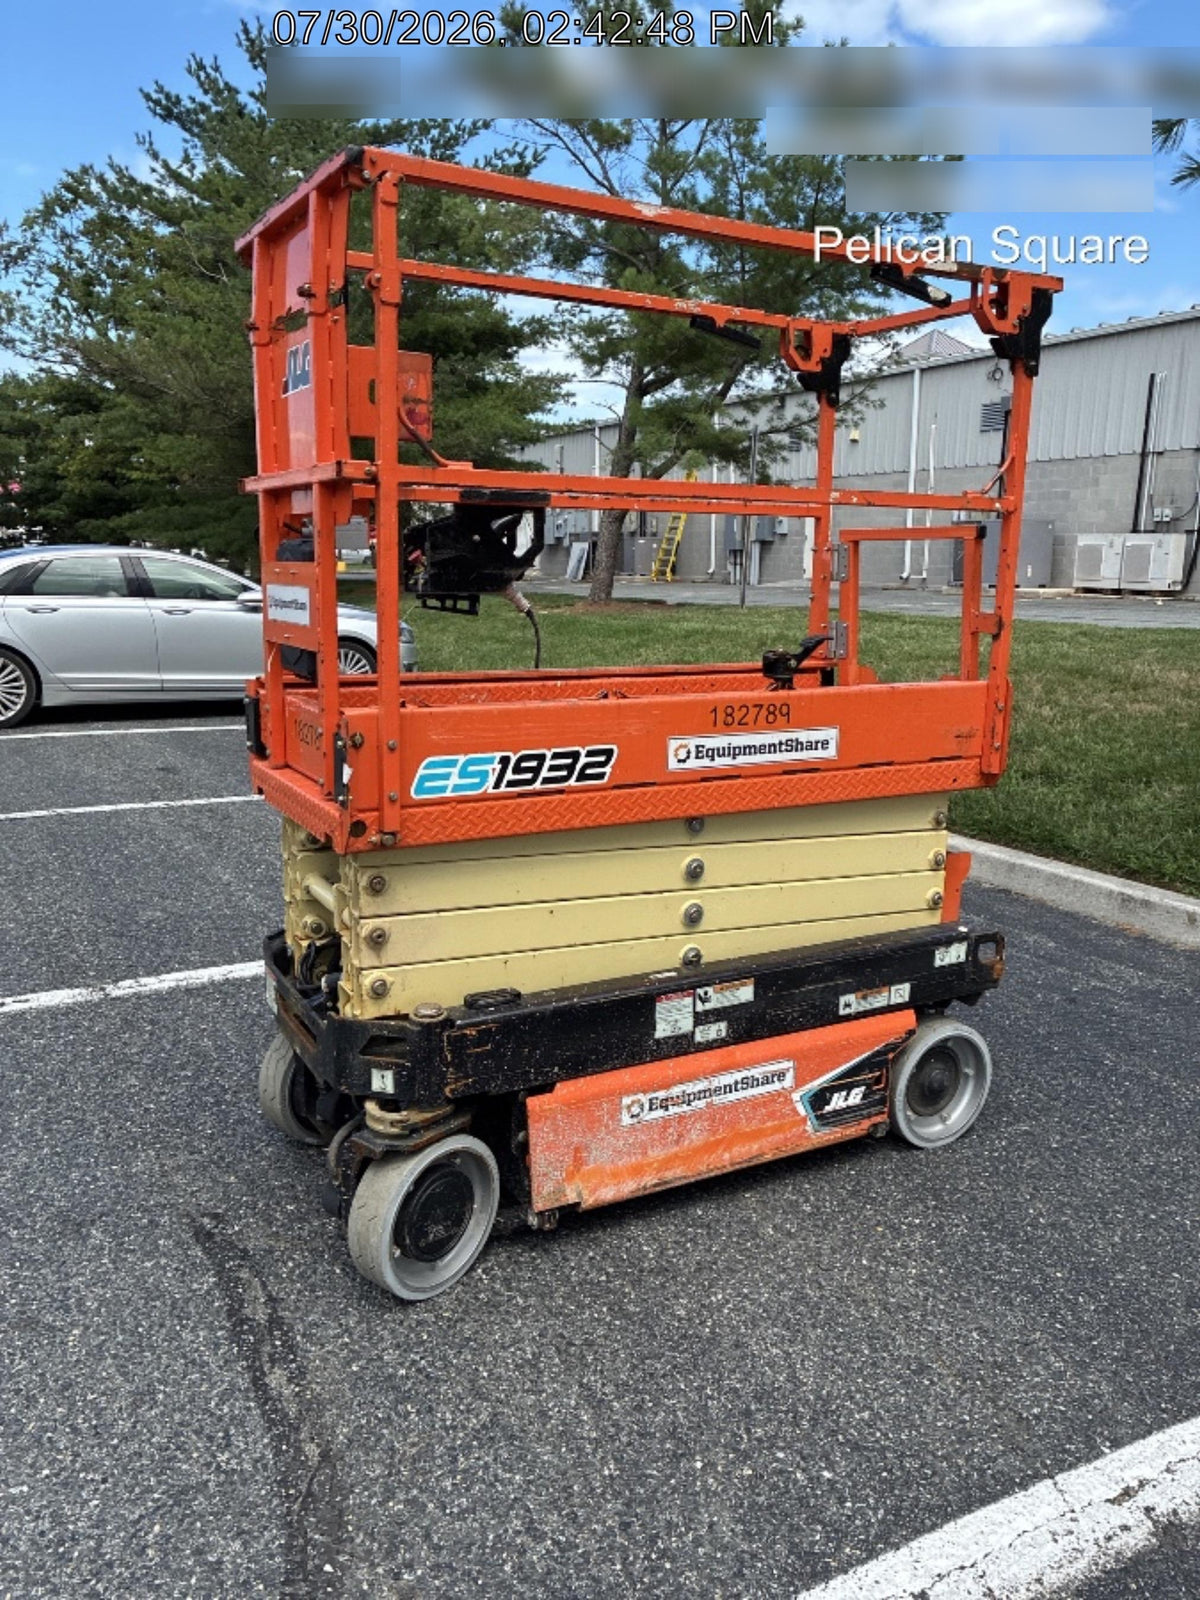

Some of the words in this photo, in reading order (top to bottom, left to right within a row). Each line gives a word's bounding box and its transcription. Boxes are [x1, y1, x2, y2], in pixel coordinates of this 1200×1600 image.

[710, 703, 791, 727] 182789
[694, 737, 830, 761] EquipmentShare
[412, 746, 617, 798] ES1932
[647, 1070, 787, 1112] EquipmentShare
[823, 1086, 867, 1114] JLG
